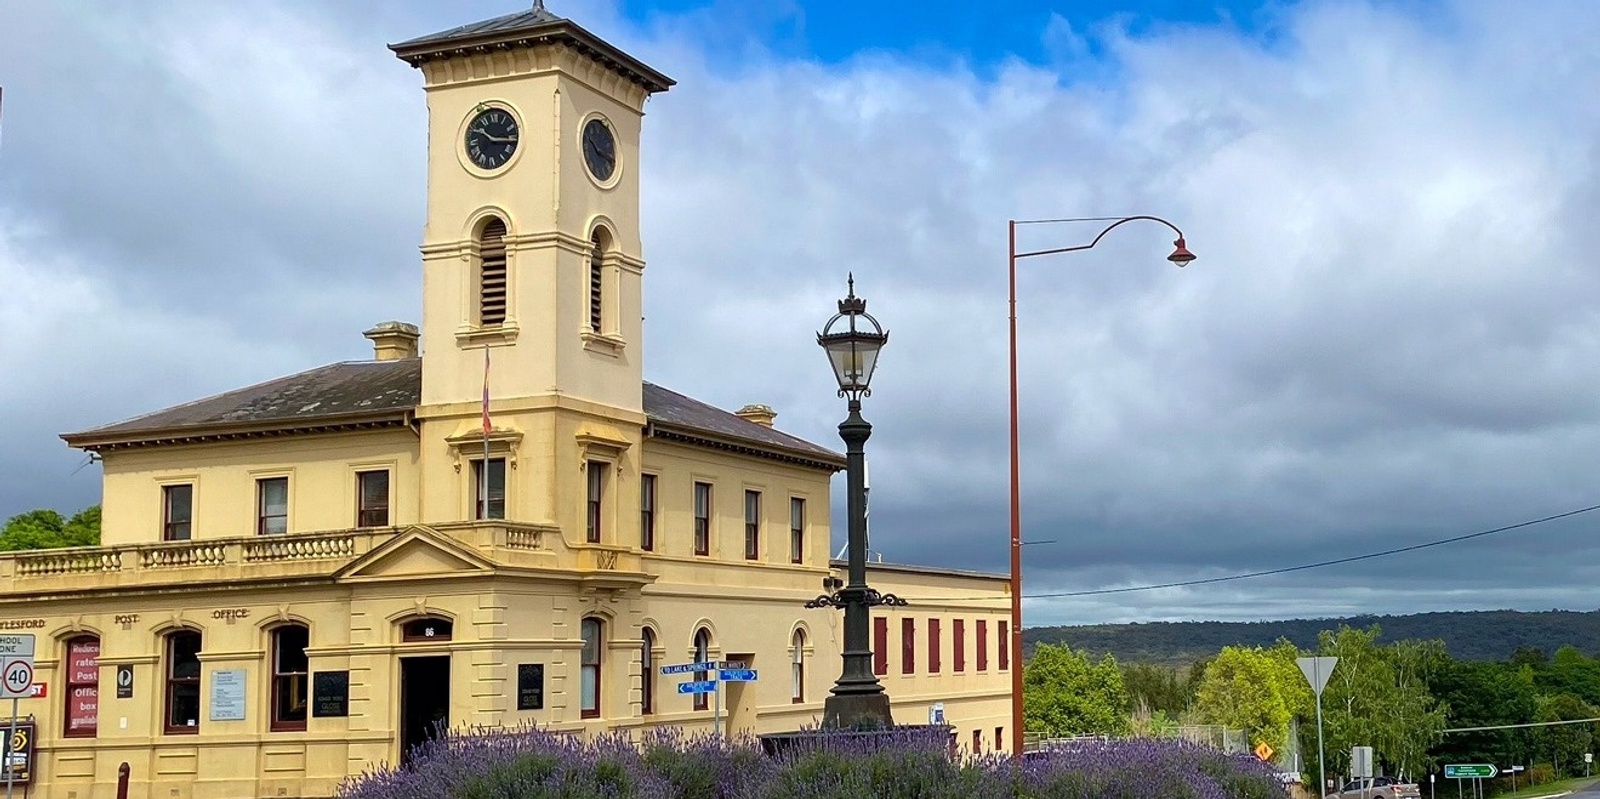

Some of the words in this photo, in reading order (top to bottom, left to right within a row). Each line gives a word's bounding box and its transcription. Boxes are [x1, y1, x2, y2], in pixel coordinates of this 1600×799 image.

[115, 614, 138, 625] POST
[213, 609, 248, 619] OFFICE
[425, 627, 435, 637] 86
[8, 670, 28, 684] 40
[77, 671, 97, 681] Post
[80, 702, 97, 711] box
